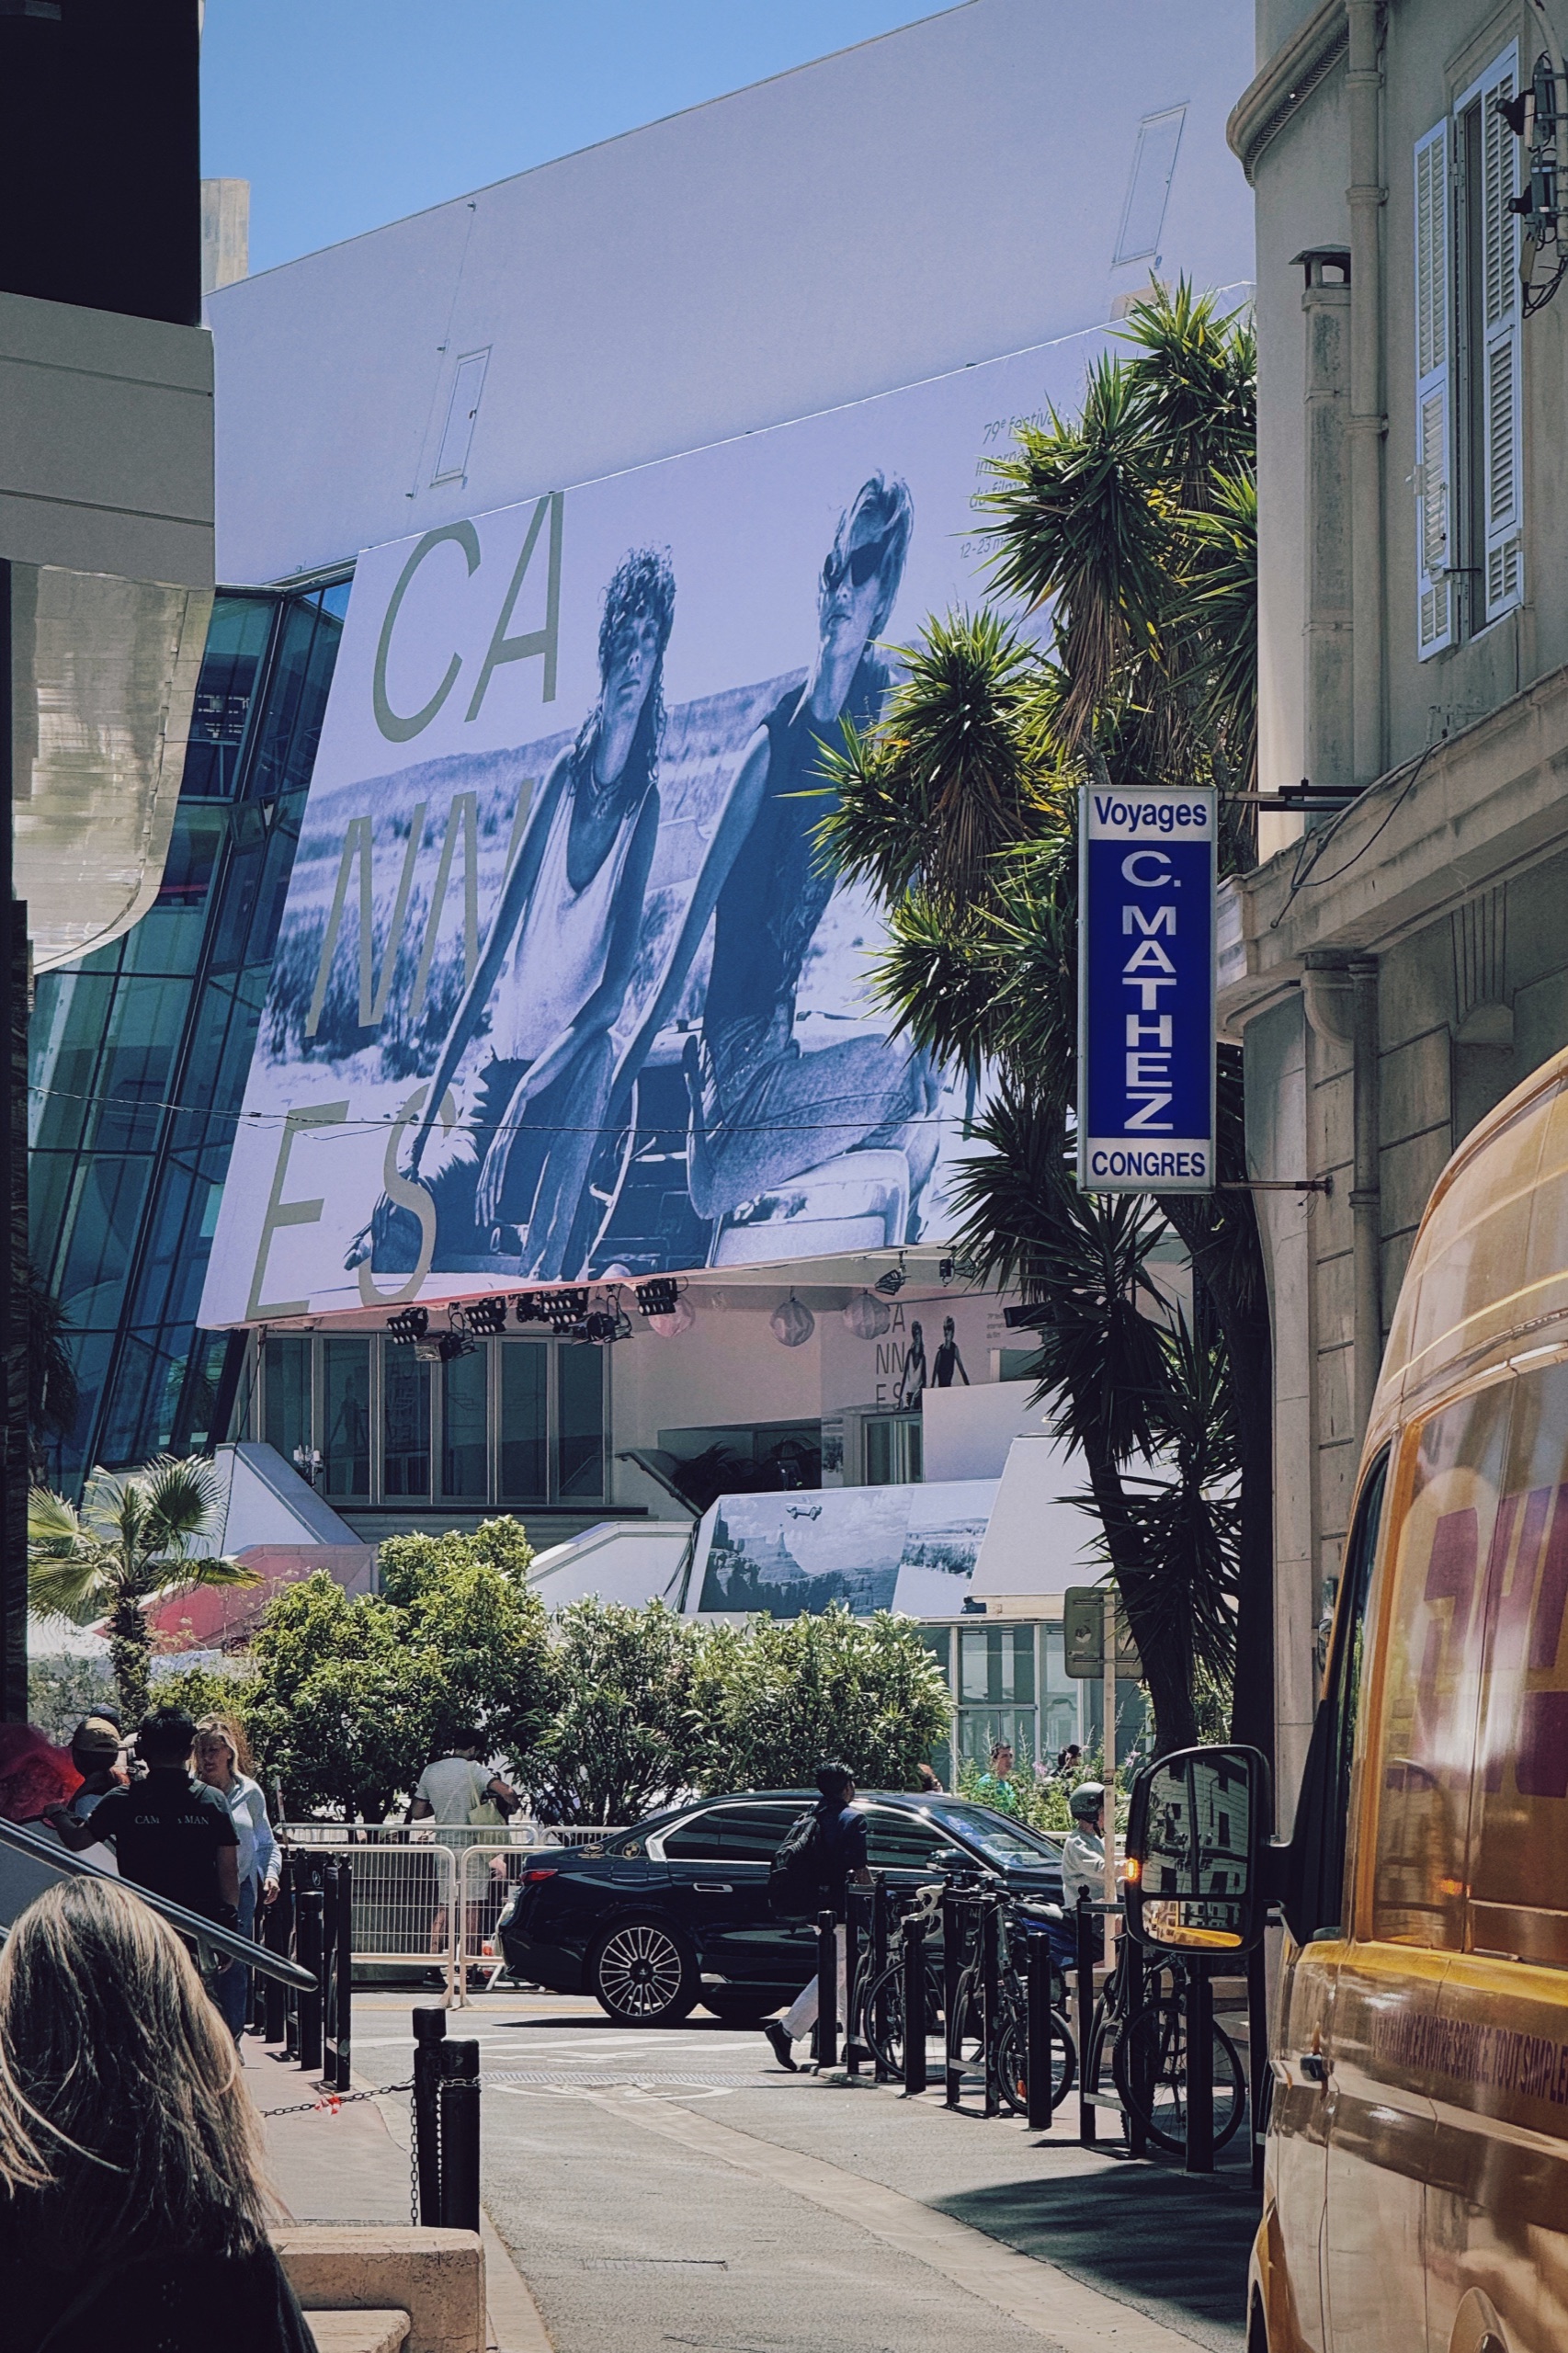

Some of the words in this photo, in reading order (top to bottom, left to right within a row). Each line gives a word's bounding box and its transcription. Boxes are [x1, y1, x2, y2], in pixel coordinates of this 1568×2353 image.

[960, 537, 991, 560] 12-23
[373, 493, 564, 743] CA
[1094, 796, 1207, 833] Voyages
[1120, 850, 1181, 888] C.
[1122, 905, 1177, 1131] MATHEZ
[1092, 1151, 1206, 1177] CONGRES
[245, 1083, 459, 1320] ES
[1492, 2027, 1524, 2091] TOUT
[1520, 2034, 1568, 2105] SIMPLE
